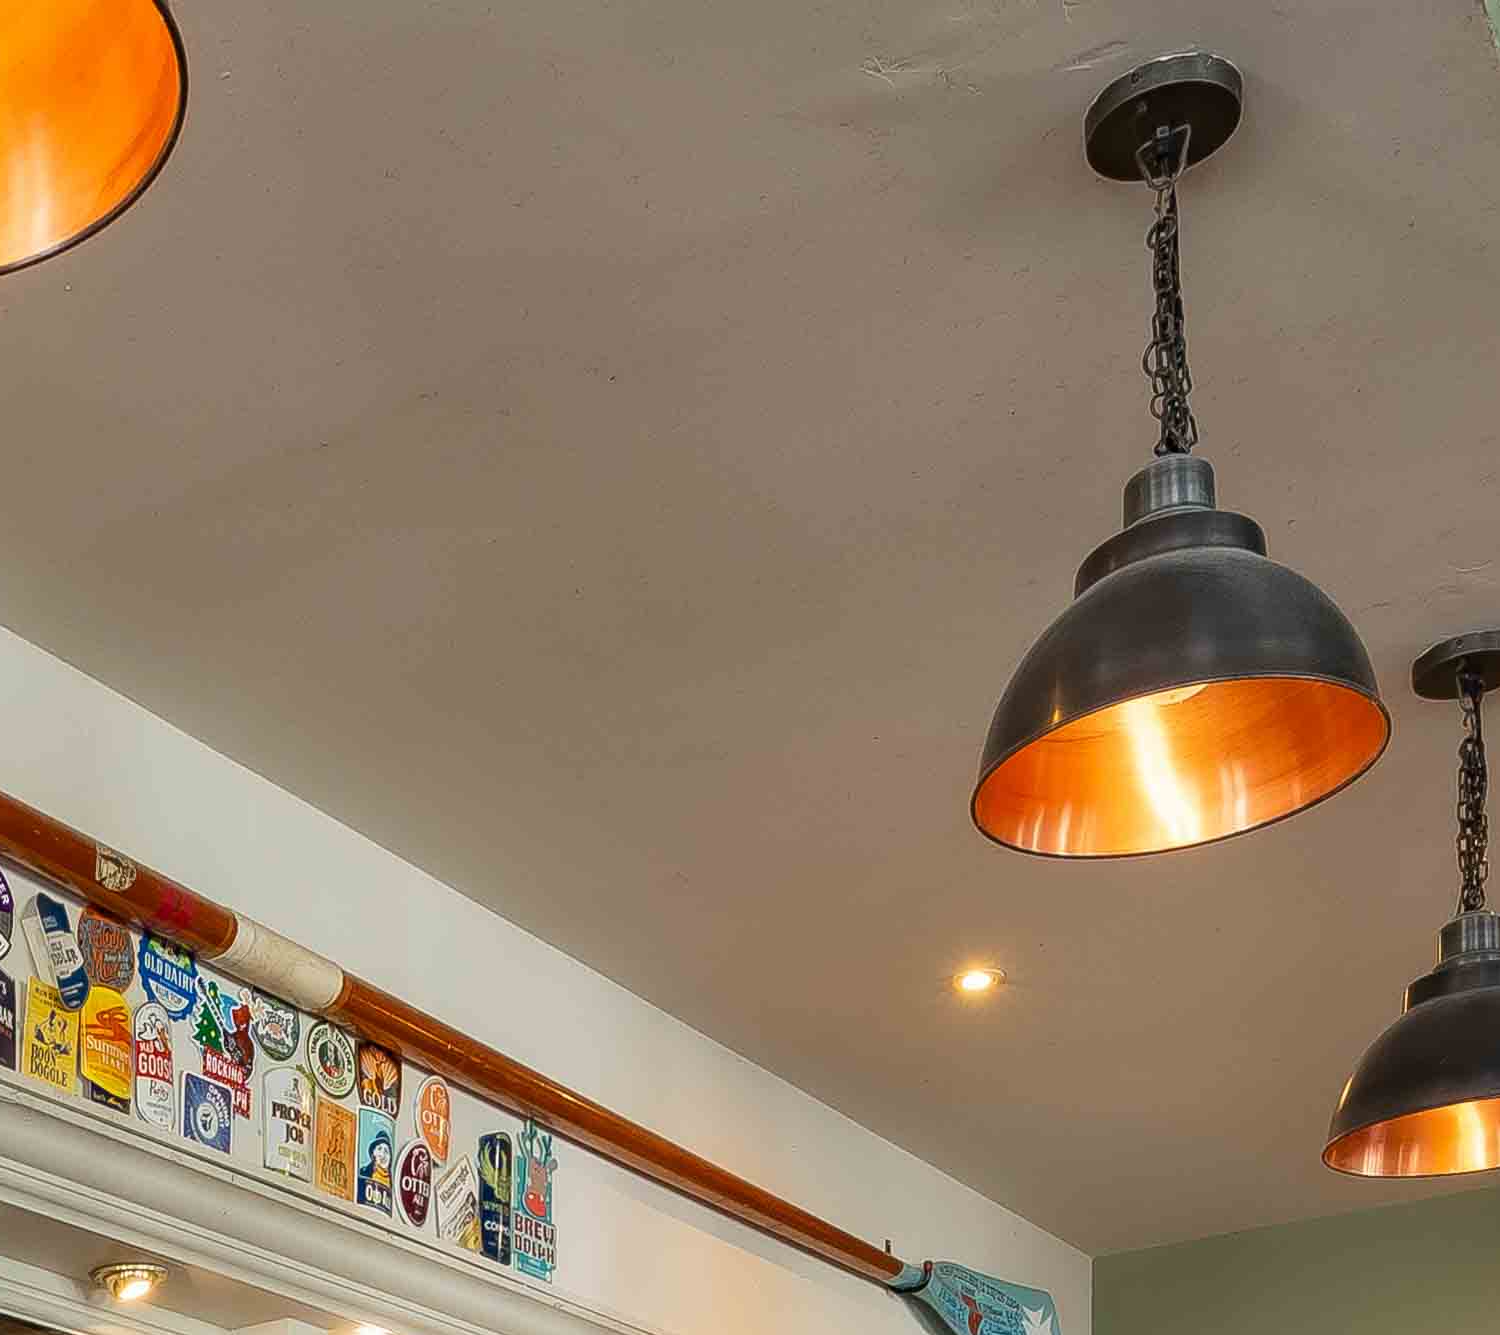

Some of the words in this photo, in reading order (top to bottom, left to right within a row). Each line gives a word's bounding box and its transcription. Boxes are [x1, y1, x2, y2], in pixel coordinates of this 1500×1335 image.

[144, 952, 163, 975] OLD
[163, 962, 196, 994] DAIRY
[87, 1035, 128, 1065] Summer
[205, 1054, 244, 1084] ROCKING
[271, 1101, 312, 1130] PROPER
[363, 1091, 397, 1115] GOLD
[285, 1124, 305, 1144] JOB
[514, 1212, 555, 1243] BREW
